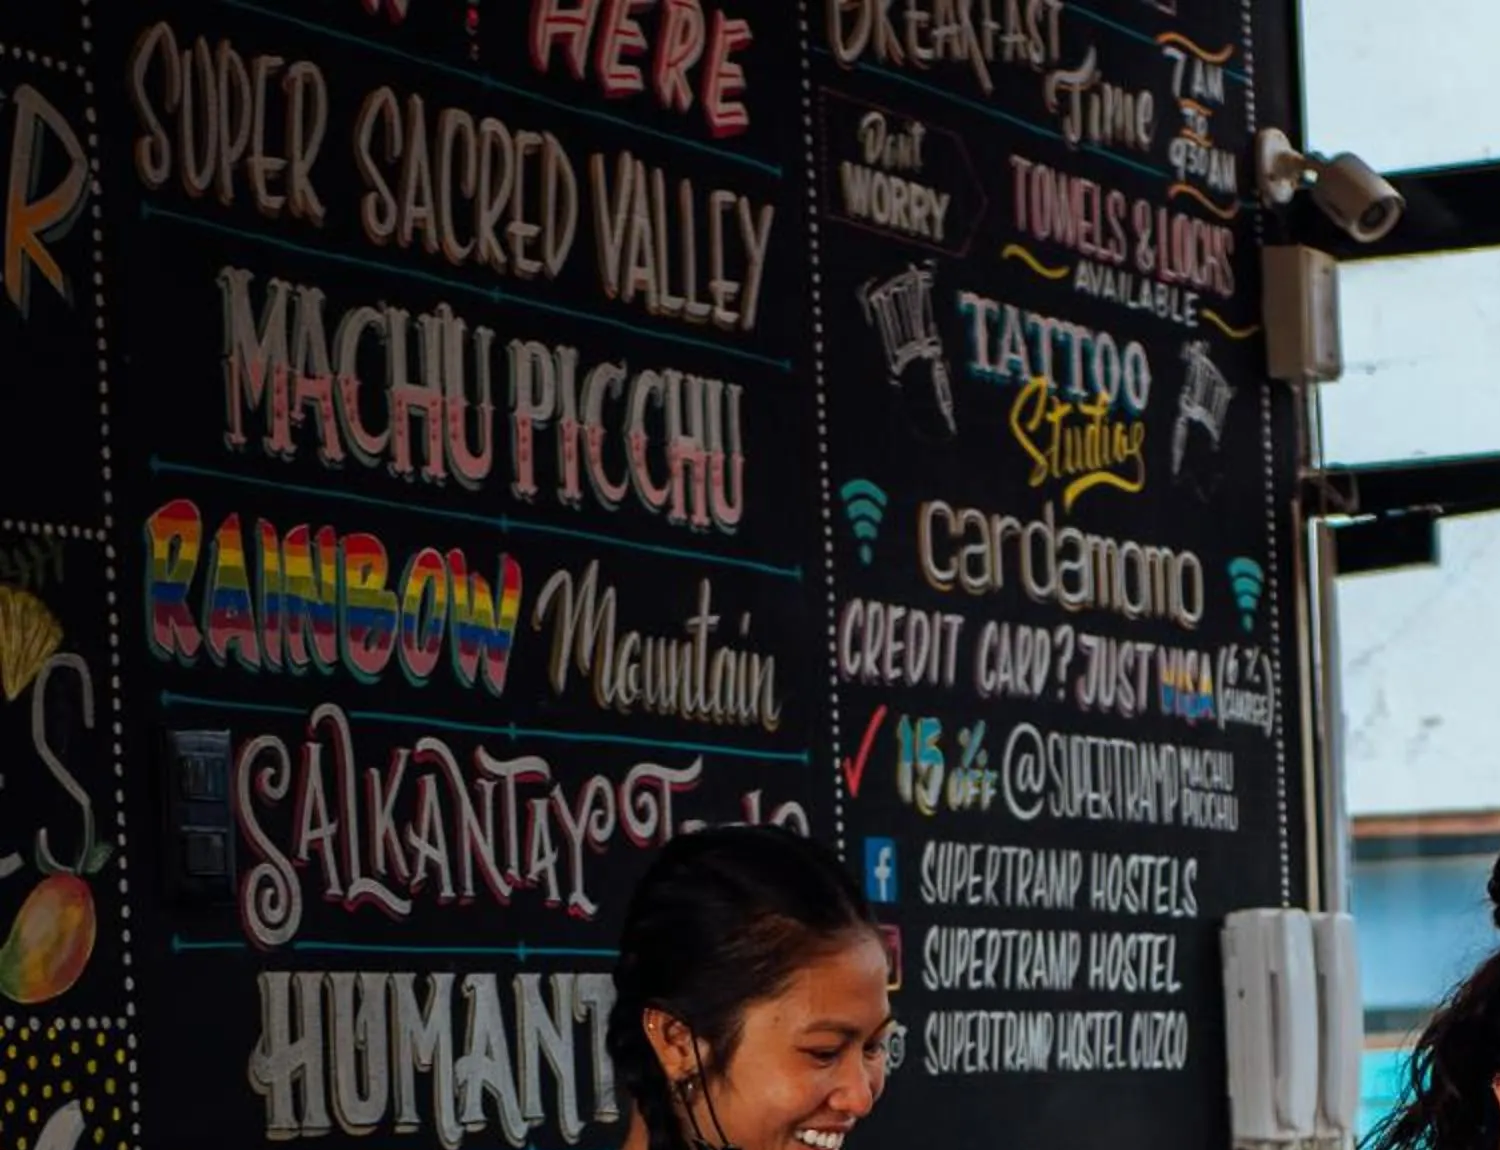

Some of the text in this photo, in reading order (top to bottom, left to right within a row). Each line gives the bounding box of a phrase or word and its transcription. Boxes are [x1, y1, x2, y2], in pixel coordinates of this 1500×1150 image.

[530, 0, 753, 138] HERE
[1163, 46, 1187, 98] 7
[131, 21, 776, 332] SUPER SACRED VALLEY
[840, 160, 951, 242] WORRY
[1008, 154, 1236, 299] TOWELS & LOCKS
[1074, 258, 1200, 328] AVAILABLE
[216, 266, 744, 533] MACHU PICCHU
[957, 291, 1152, 416] TATTOO
[142, 498, 781, 729] RAINBOW Mountain
[918, 500, 1204, 630] cardamomo
[838, 599, 965, 686] CREDIT
[1077, 632, 1157, 713] JUST
[896, 713, 946, 816] 15
[1180, 747, 1235, 792] MACHU
[235, 702, 613, 948] SALKANTAY
[920, 841, 1199, 918] SUPERTRAMP HOSTELS
[922, 925, 1182, 993] SUPERTRAMP HOSTEL
[924, 1009, 1190, 1076] SUPERTRAMP HOSTEL CUZCO
